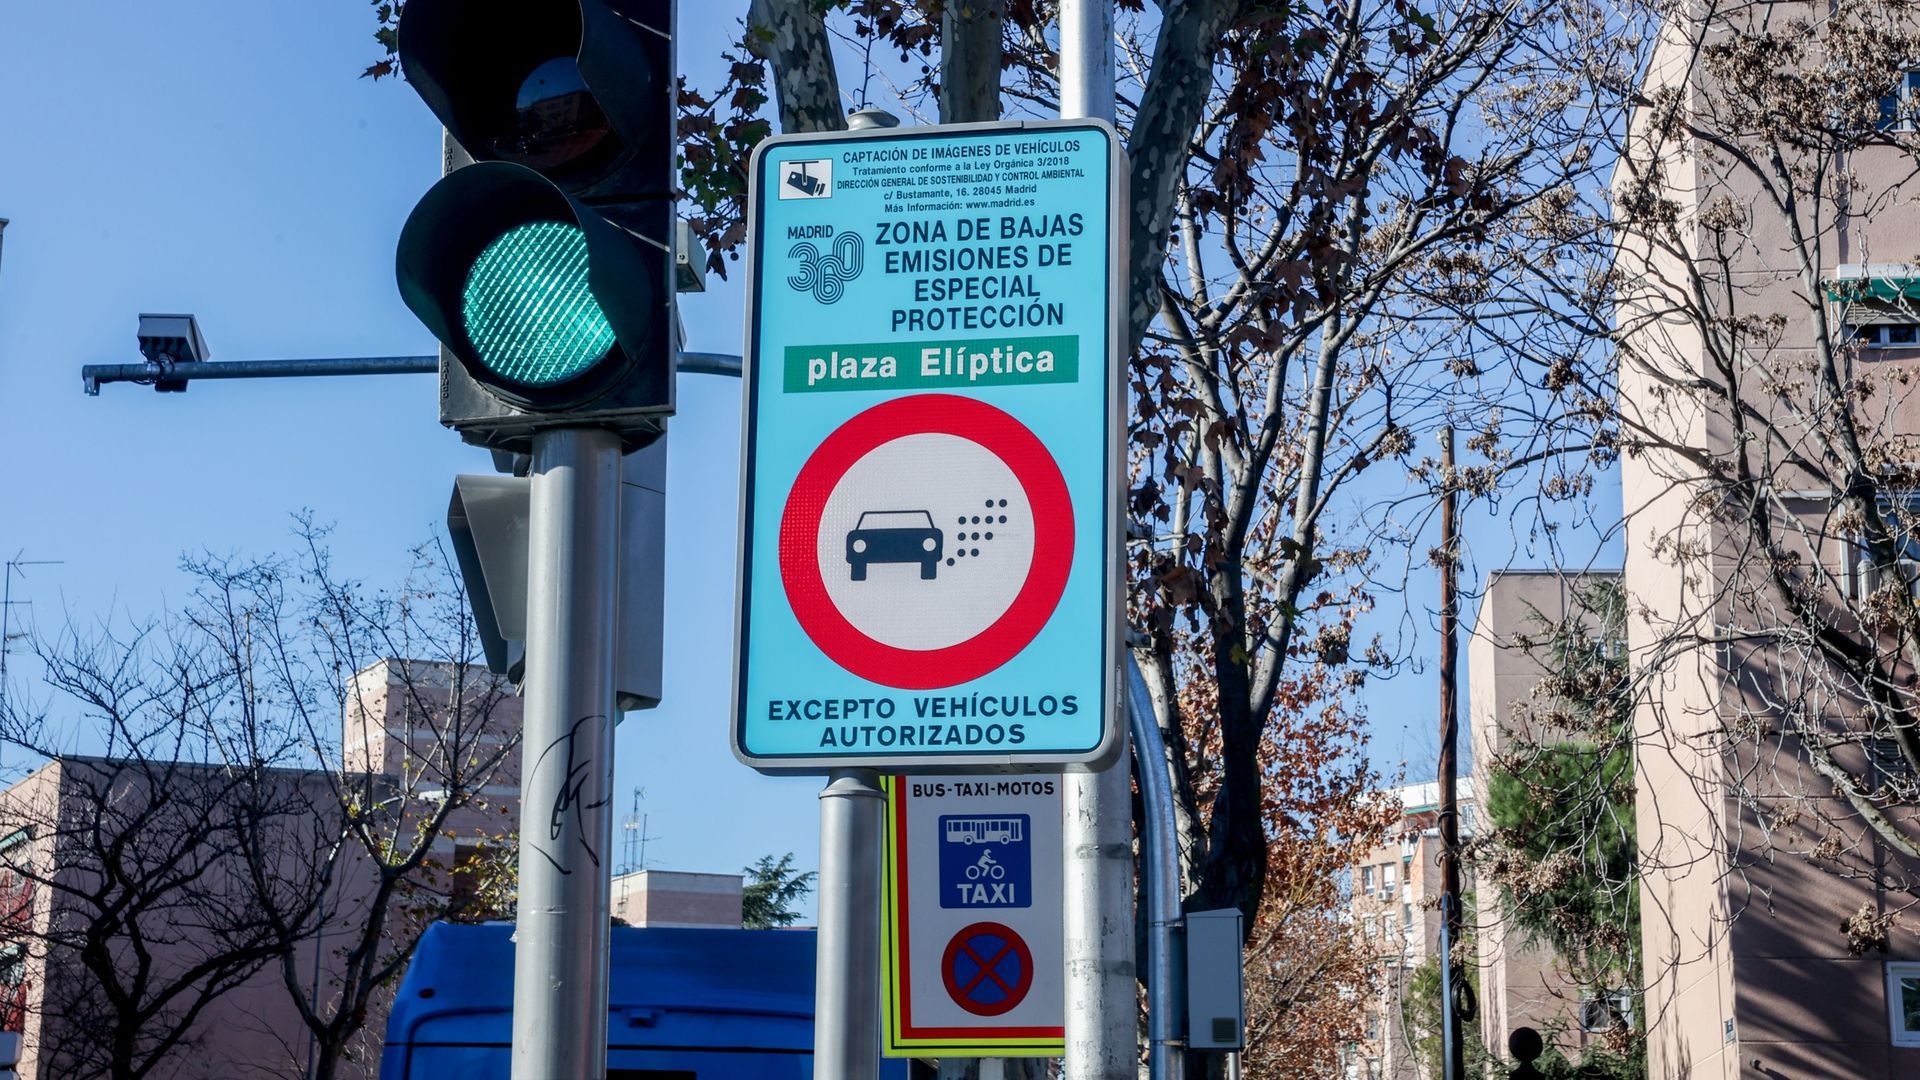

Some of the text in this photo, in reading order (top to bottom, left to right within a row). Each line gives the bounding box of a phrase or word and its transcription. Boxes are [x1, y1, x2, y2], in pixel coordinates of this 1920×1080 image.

[843, 140, 1080, 164] CAPTACIÓN DE IMÁGENES DE VEHÍCULOS
[852, 165, 906, 176] Tratamiento
[909, 163, 952, 173] conforme
[963, 161, 971, 170] la
[974, 161, 991, 170] Ley
[994, 158, 1034, 169] Orgánica
[1037, 156, 1069, 167] 3/2018
[837, 168, 1085, 189] DIRECCIÓN GENERAL DE SOSTENIBILIDAD Y CONTROL AMBIENTAL
[884, 184, 1037, 200] c/ Bustamante, 16. 28045 Madrid
[885, 198, 1035, 213] Más Información: www.madrid.es
[787, 225, 834, 240] MADRID
[875, 213, 1083, 245] ZONA DE BAJAS
[787, 231, 864, 305] 360
[885, 243, 1072, 274] EMISIONES DE
[915, 274, 1040, 302] ESPECIAL
[892, 299, 1063, 332] PROTECCIÓN
[808, 345, 1054, 386] plaza Elíptica
[768, 693, 1078, 721] EXCEPTO VEHÍCULOS
[819, 724, 1025, 747] AUTORIZADOS
[957, 883, 1014, 904] TAXI
